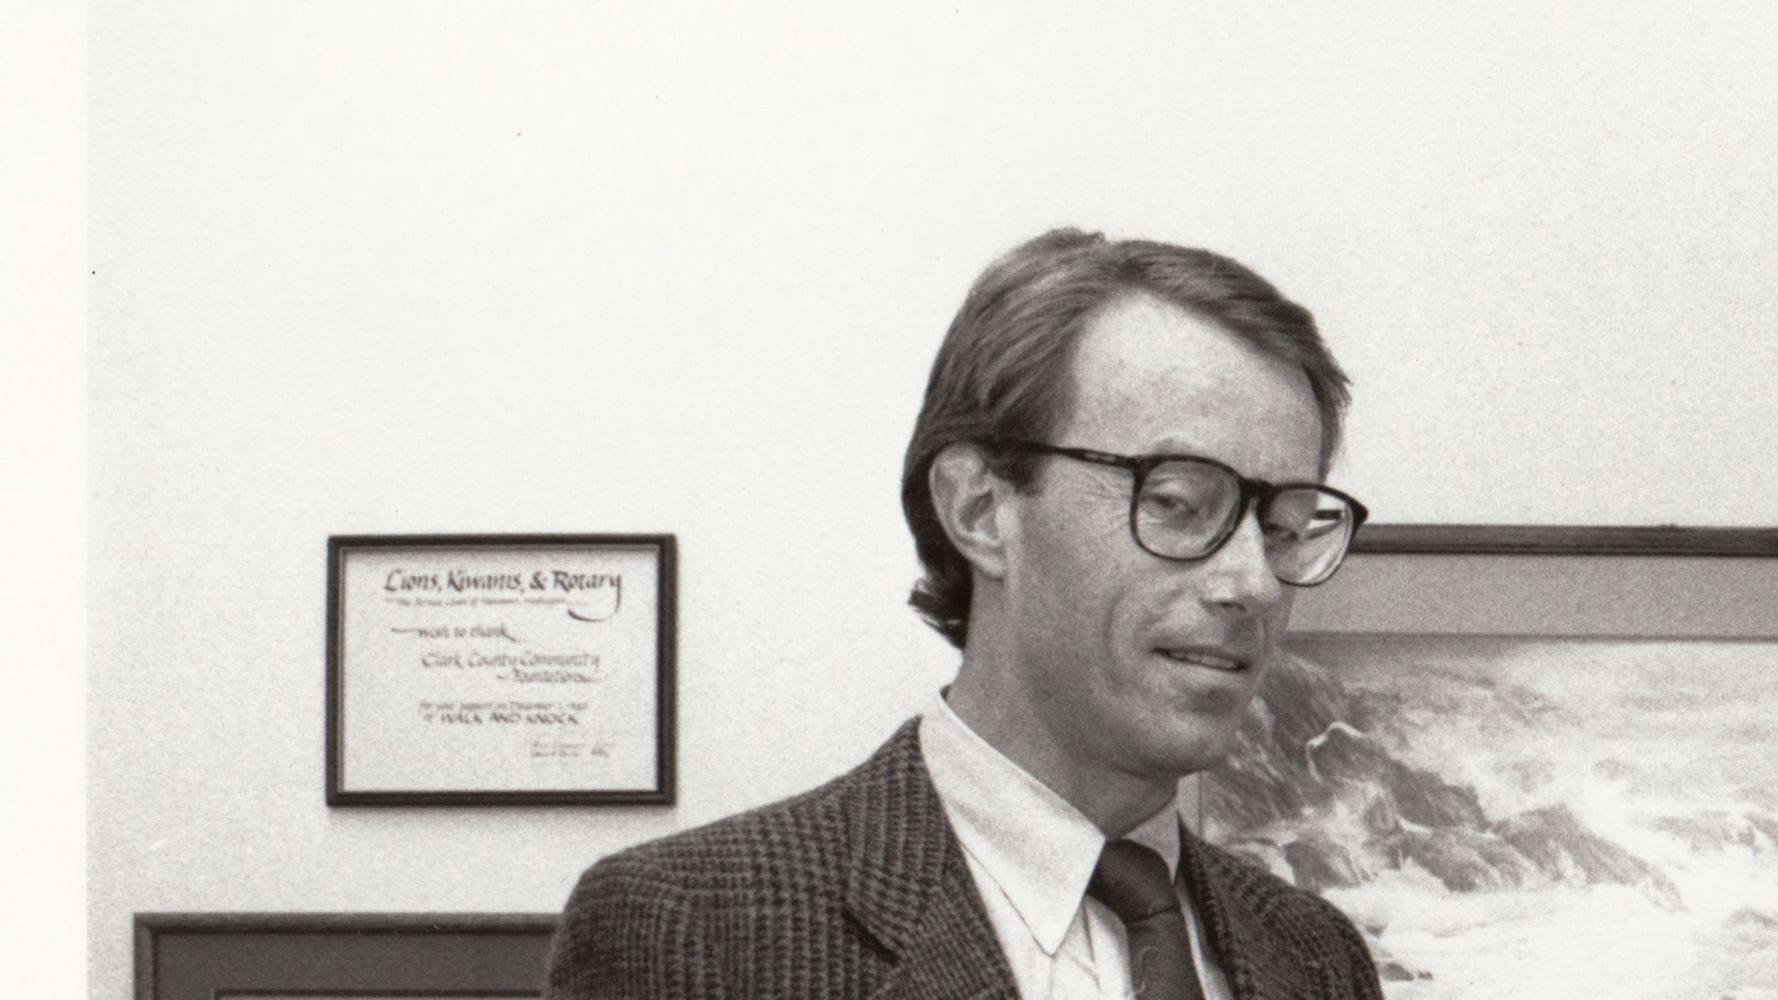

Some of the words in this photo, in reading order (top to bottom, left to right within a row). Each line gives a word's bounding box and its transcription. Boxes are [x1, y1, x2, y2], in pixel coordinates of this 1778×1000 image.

[384, 568, 442, 593] Lions,
[447, 568, 526, 595] Kiwanis,
[529, 569, 548, 591] &
[551, 569, 622, 623] Rotary
